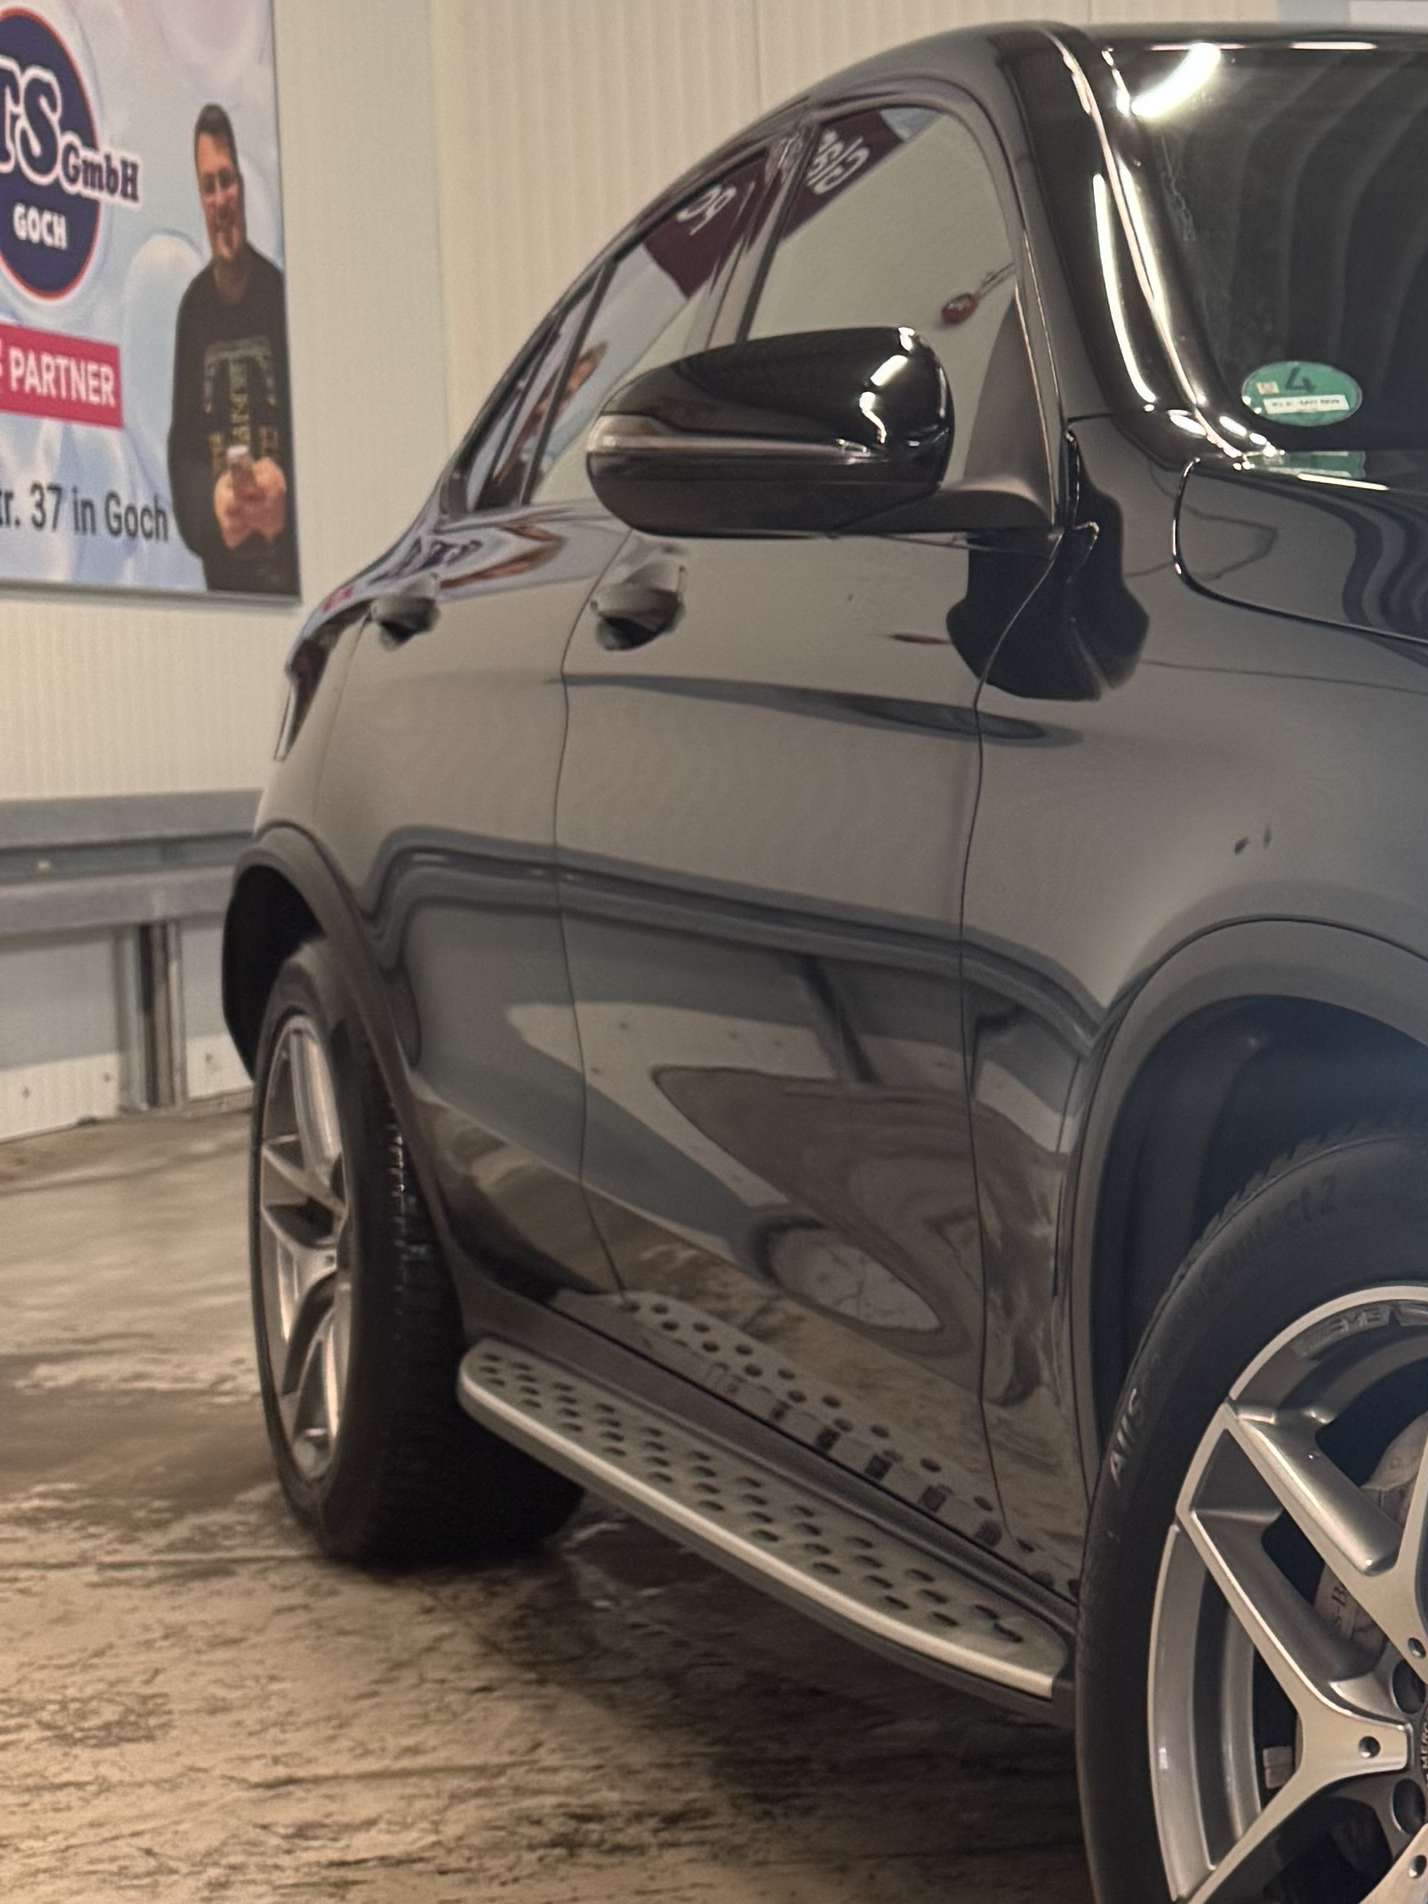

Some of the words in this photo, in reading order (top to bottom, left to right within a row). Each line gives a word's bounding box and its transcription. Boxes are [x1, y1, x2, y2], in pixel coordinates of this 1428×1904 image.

[61, 141, 140, 203] GmbH
[13, 202, 68, 250] GOCH
[8, 345, 117, 408] PARTNER
[1285, 367, 1316, 393] 4
[0, 489, 21, 527] r.
[30, 481, 63, 532] 37
[72, 485, 97, 536] in
[104, 489, 170, 542] Goch
